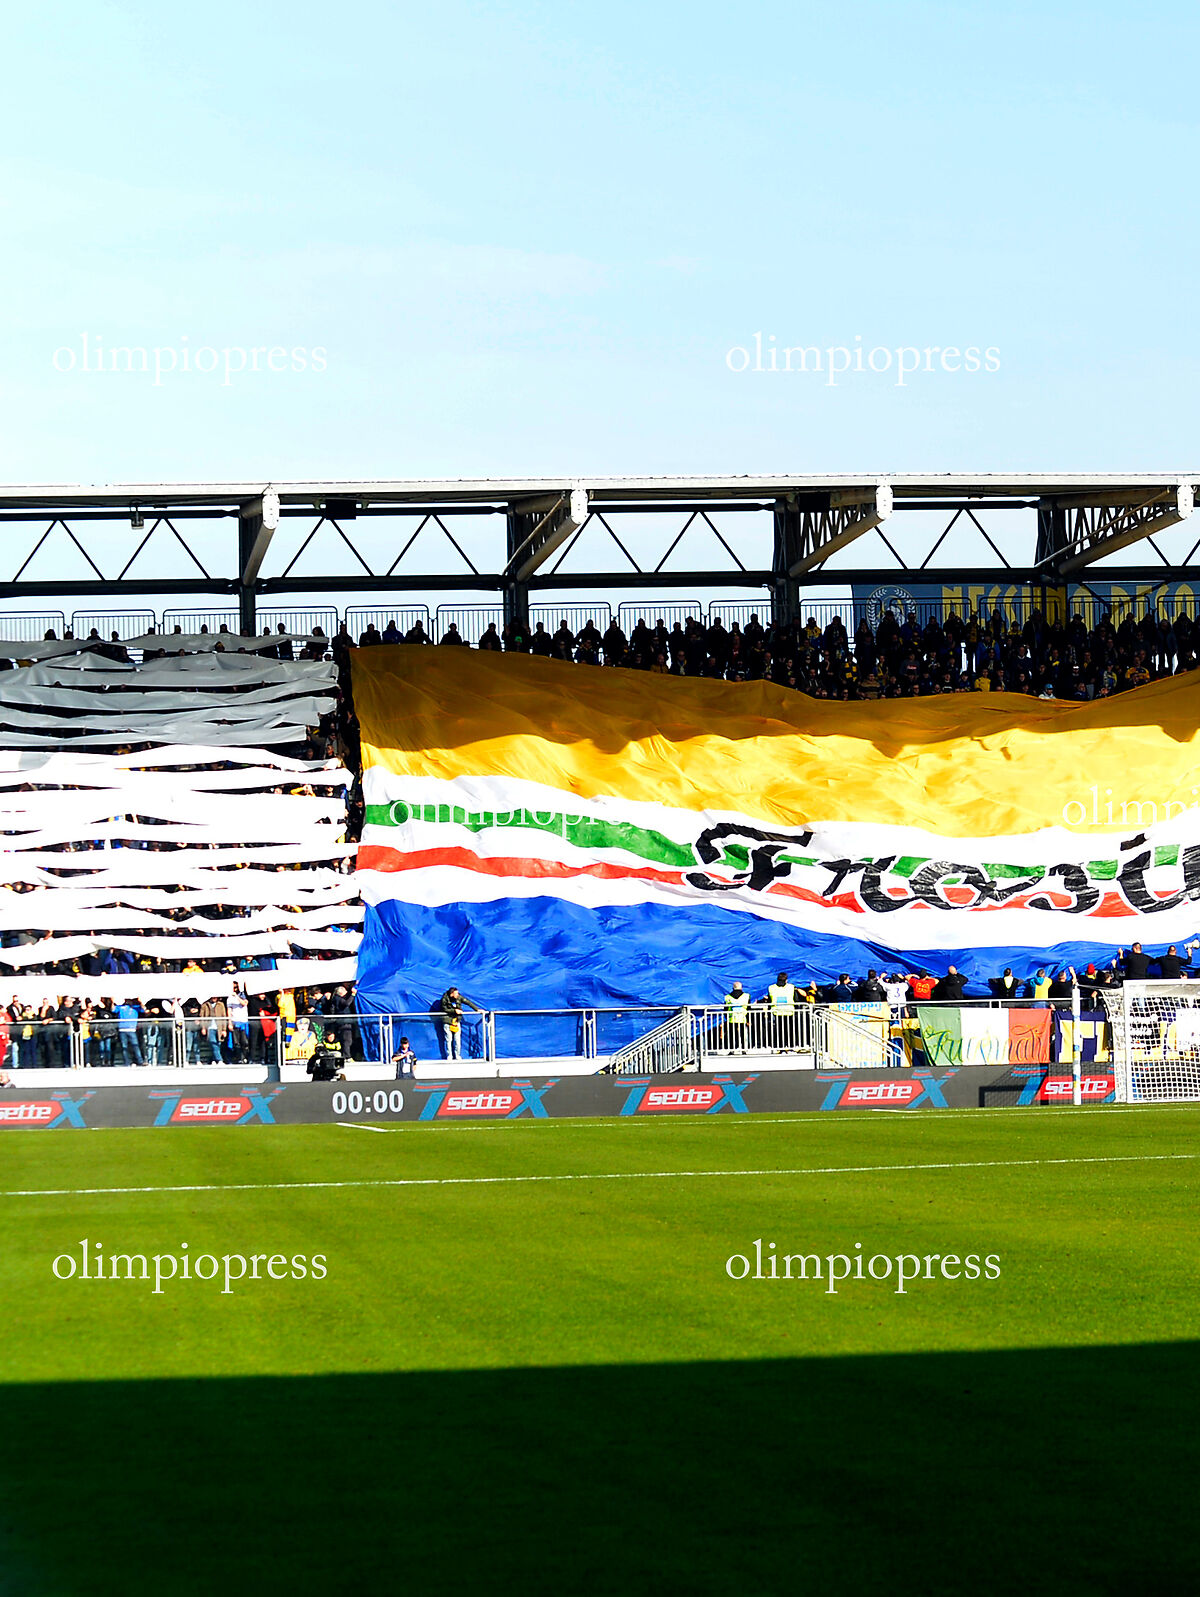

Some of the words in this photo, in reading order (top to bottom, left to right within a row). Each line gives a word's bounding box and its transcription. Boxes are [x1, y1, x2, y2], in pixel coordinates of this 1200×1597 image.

[647, 1088, 712, 1105] sette
[848, 1084, 912, 1100] sette
[180, 1100, 241, 1117] sette
[332, 1090, 404, 1114] 00:00
[447, 1093, 512, 1110] sette
